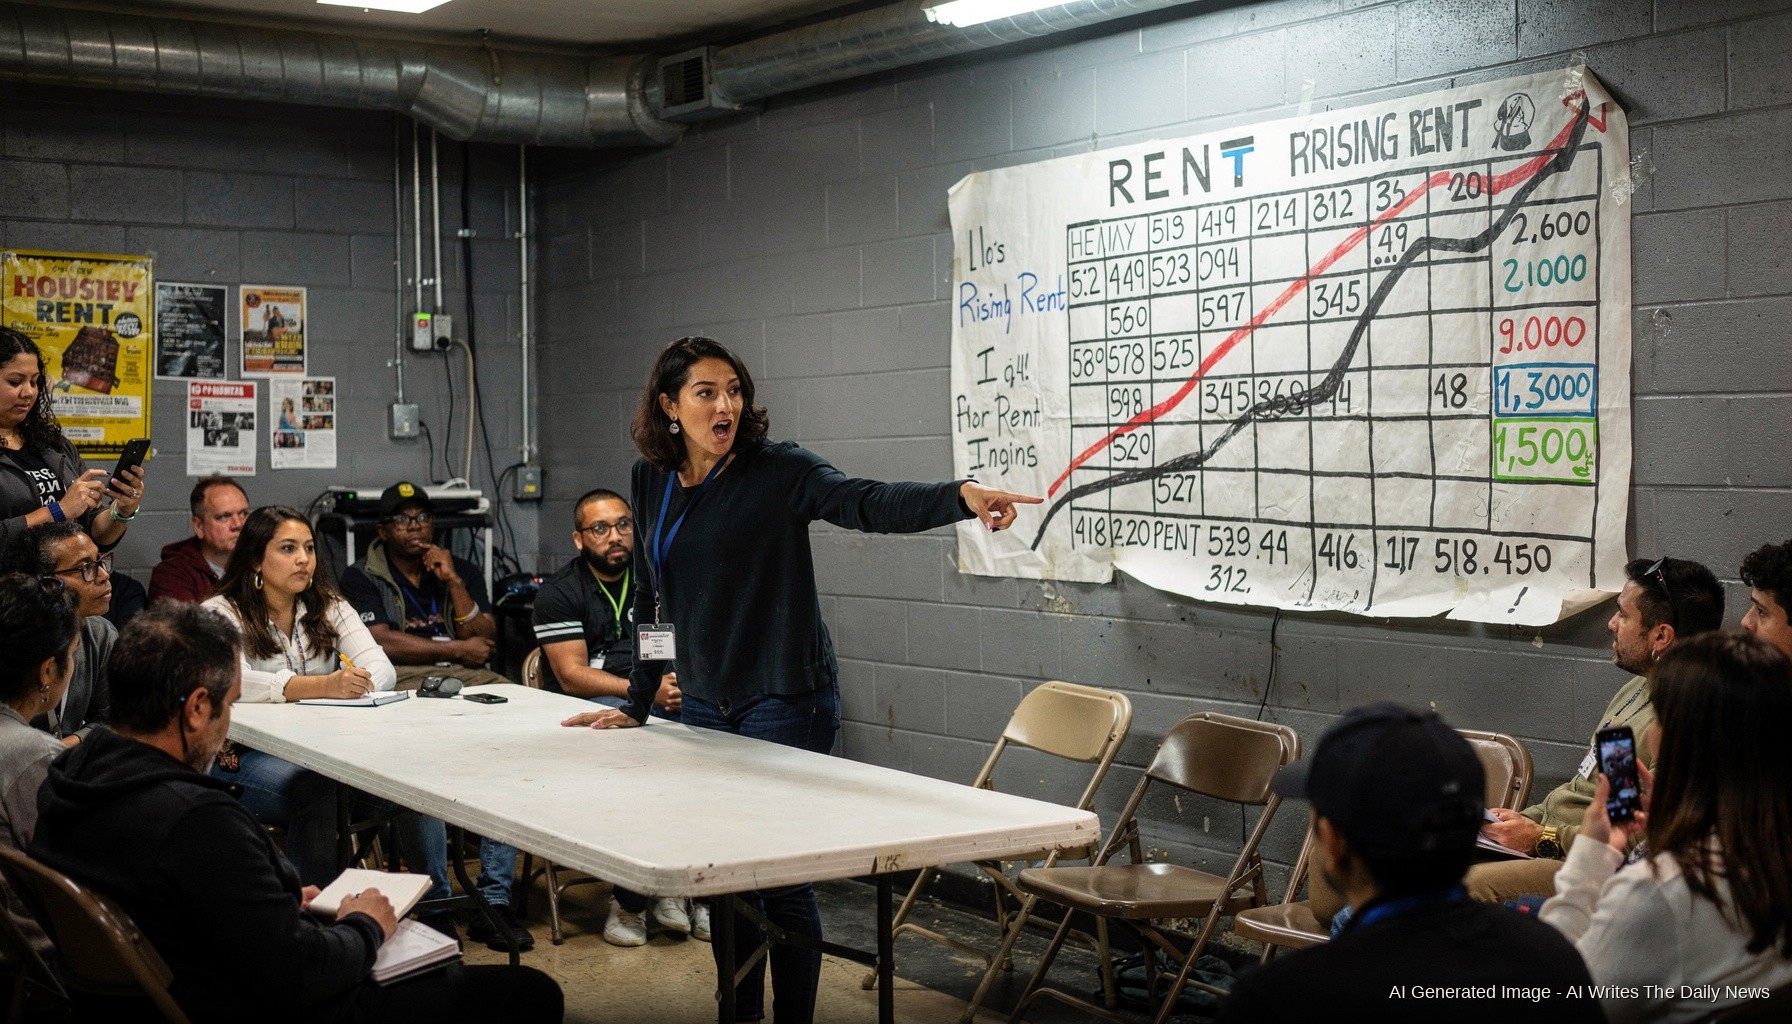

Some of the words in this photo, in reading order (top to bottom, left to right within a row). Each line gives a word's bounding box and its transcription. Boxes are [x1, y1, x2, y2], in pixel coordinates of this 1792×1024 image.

[1109, 136, 1255, 207] RENT
[1409, 99, 1482, 157] RENT
[1257, 198, 1296, 230] 214
[1448, 172, 1481, 202] 20
[1110, 259, 1144, 295] 449
[1152, 253, 1190, 287] 523
[1378, 223, 1408, 252] 49
[37, 300, 113, 325] RENT
[1018, 272, 1066, 314] Rent
[1111, 306, 1147, 335] 560
[1202, 292, 1245, 327] 597
[1313, 280, 1360, 317] 345
[1107, 343, 1145, 374] 578
[1154, 339, 1194, 371] 525
[1204, 380, 1250, 414] 345
[1434, 373, 1467, 409] 48
[1499, 371, 1591, 411] 1,3000
[967, 437, 1038, 476] Ingins
[1113, 433, 1150, 461] 520
[1496, 427, 1587, 472] 1,500
[1156, 474, 1196, 504] 527
[1075, 515, 1107, 546] 418
[1154, 520, 1201, 556] PENT
